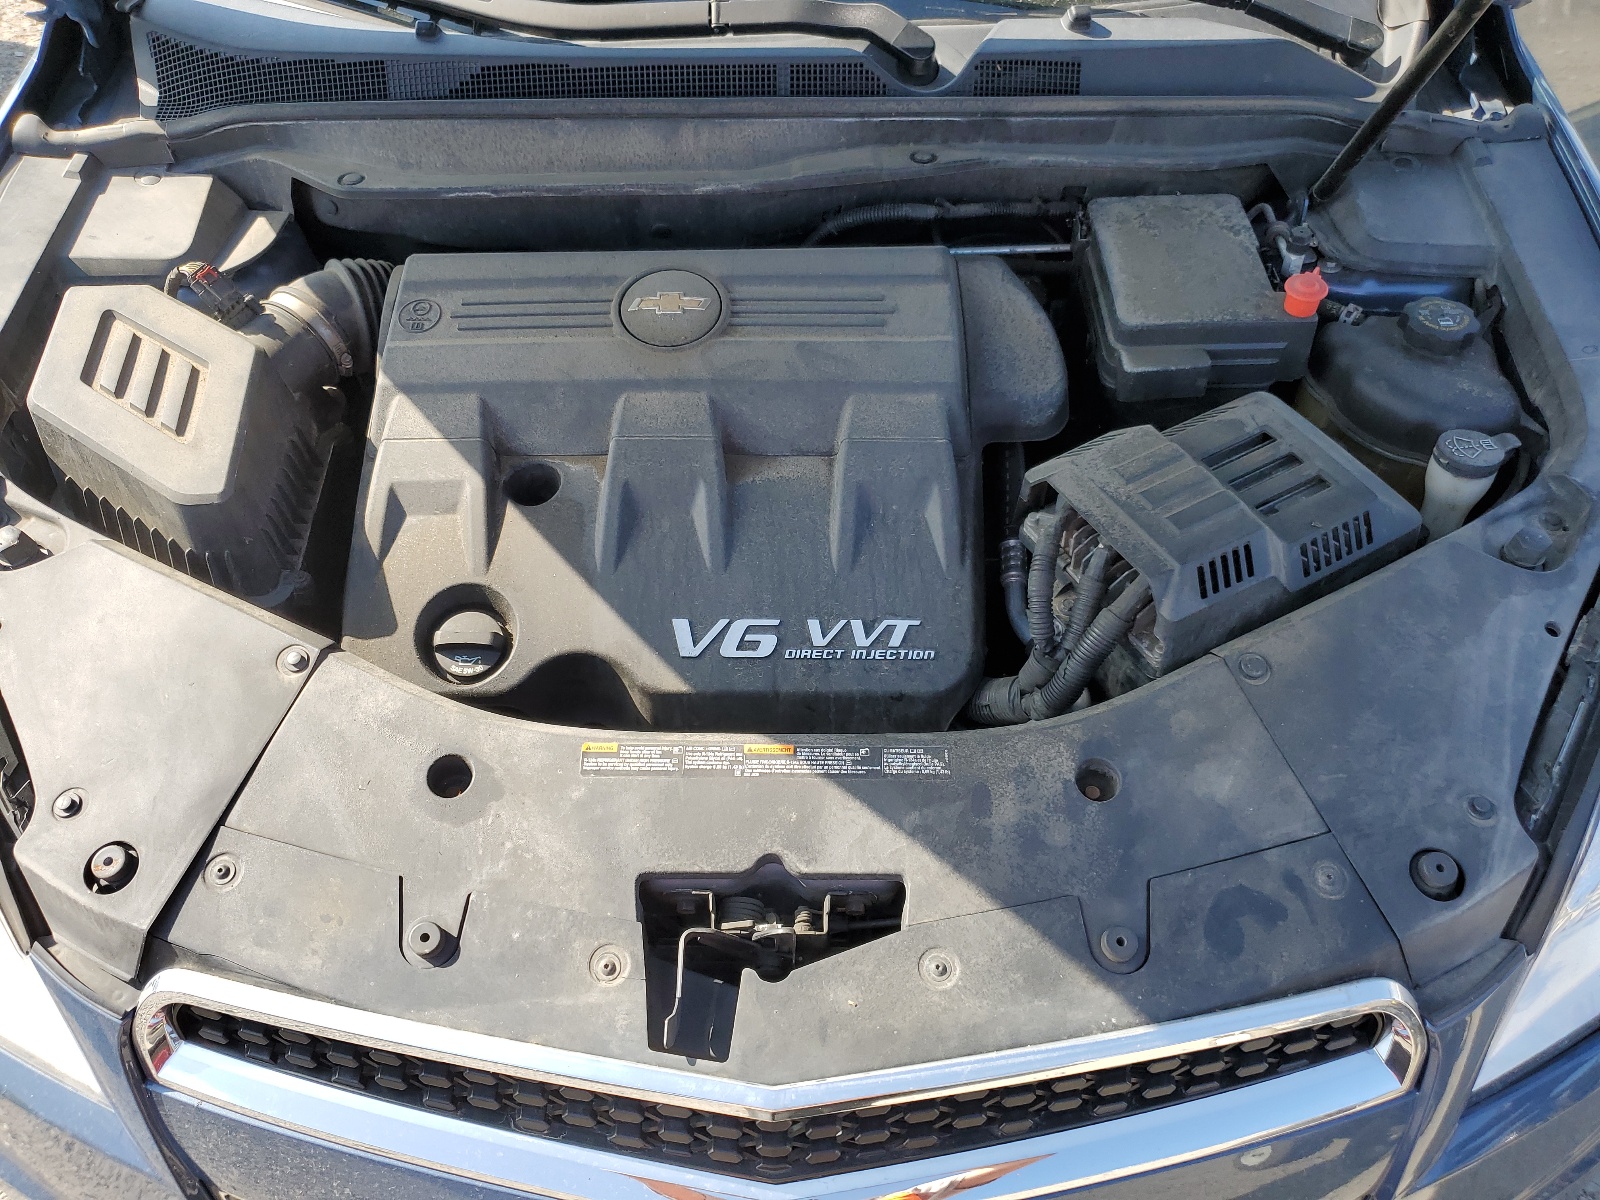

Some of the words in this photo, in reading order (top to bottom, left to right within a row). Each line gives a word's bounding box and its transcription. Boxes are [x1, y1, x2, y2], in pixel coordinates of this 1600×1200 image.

[672, 618, 781, 658] V6
[806, 618, 922, 647] VVT
[784, 649, 844, 660] DIRECT
[850, 649, 935, 661] INJECTION
